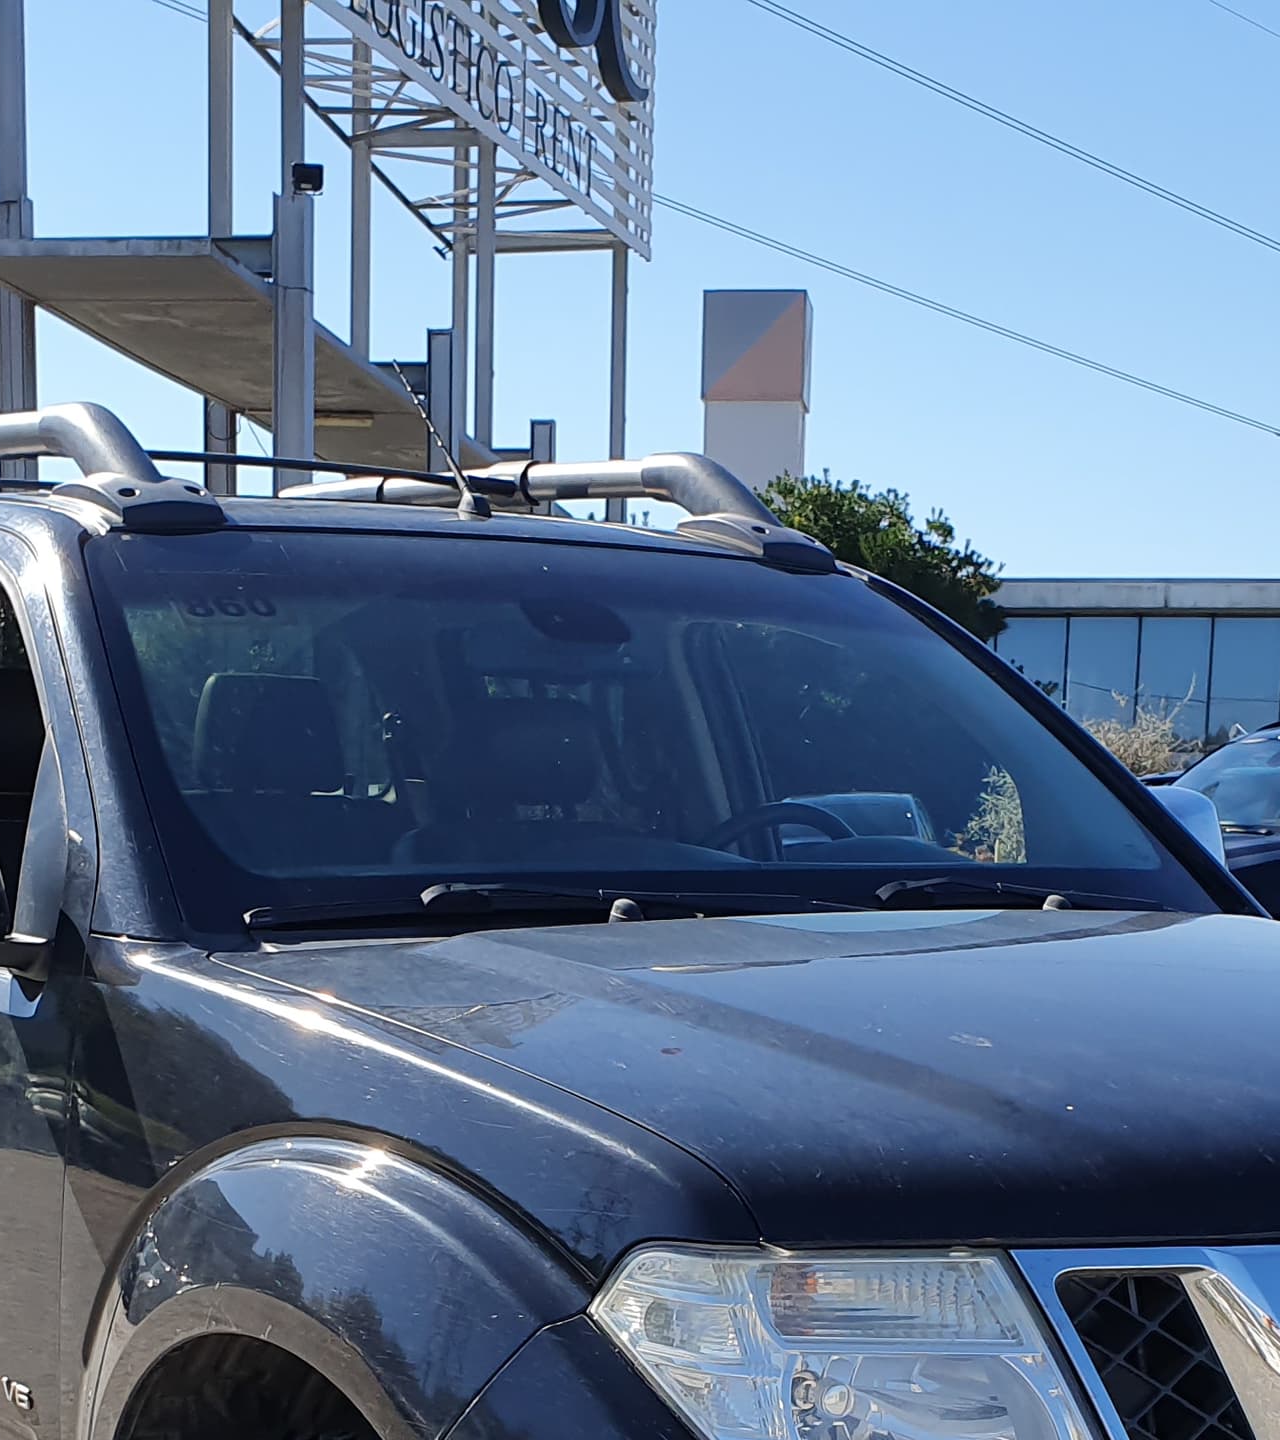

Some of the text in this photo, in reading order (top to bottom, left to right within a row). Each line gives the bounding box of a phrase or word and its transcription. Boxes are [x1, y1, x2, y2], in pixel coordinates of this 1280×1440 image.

[348, 0, 514, 134] OGISTICO
[535, 87, 598, 198] RENT
[0, 1376, 30, 1410] V6
